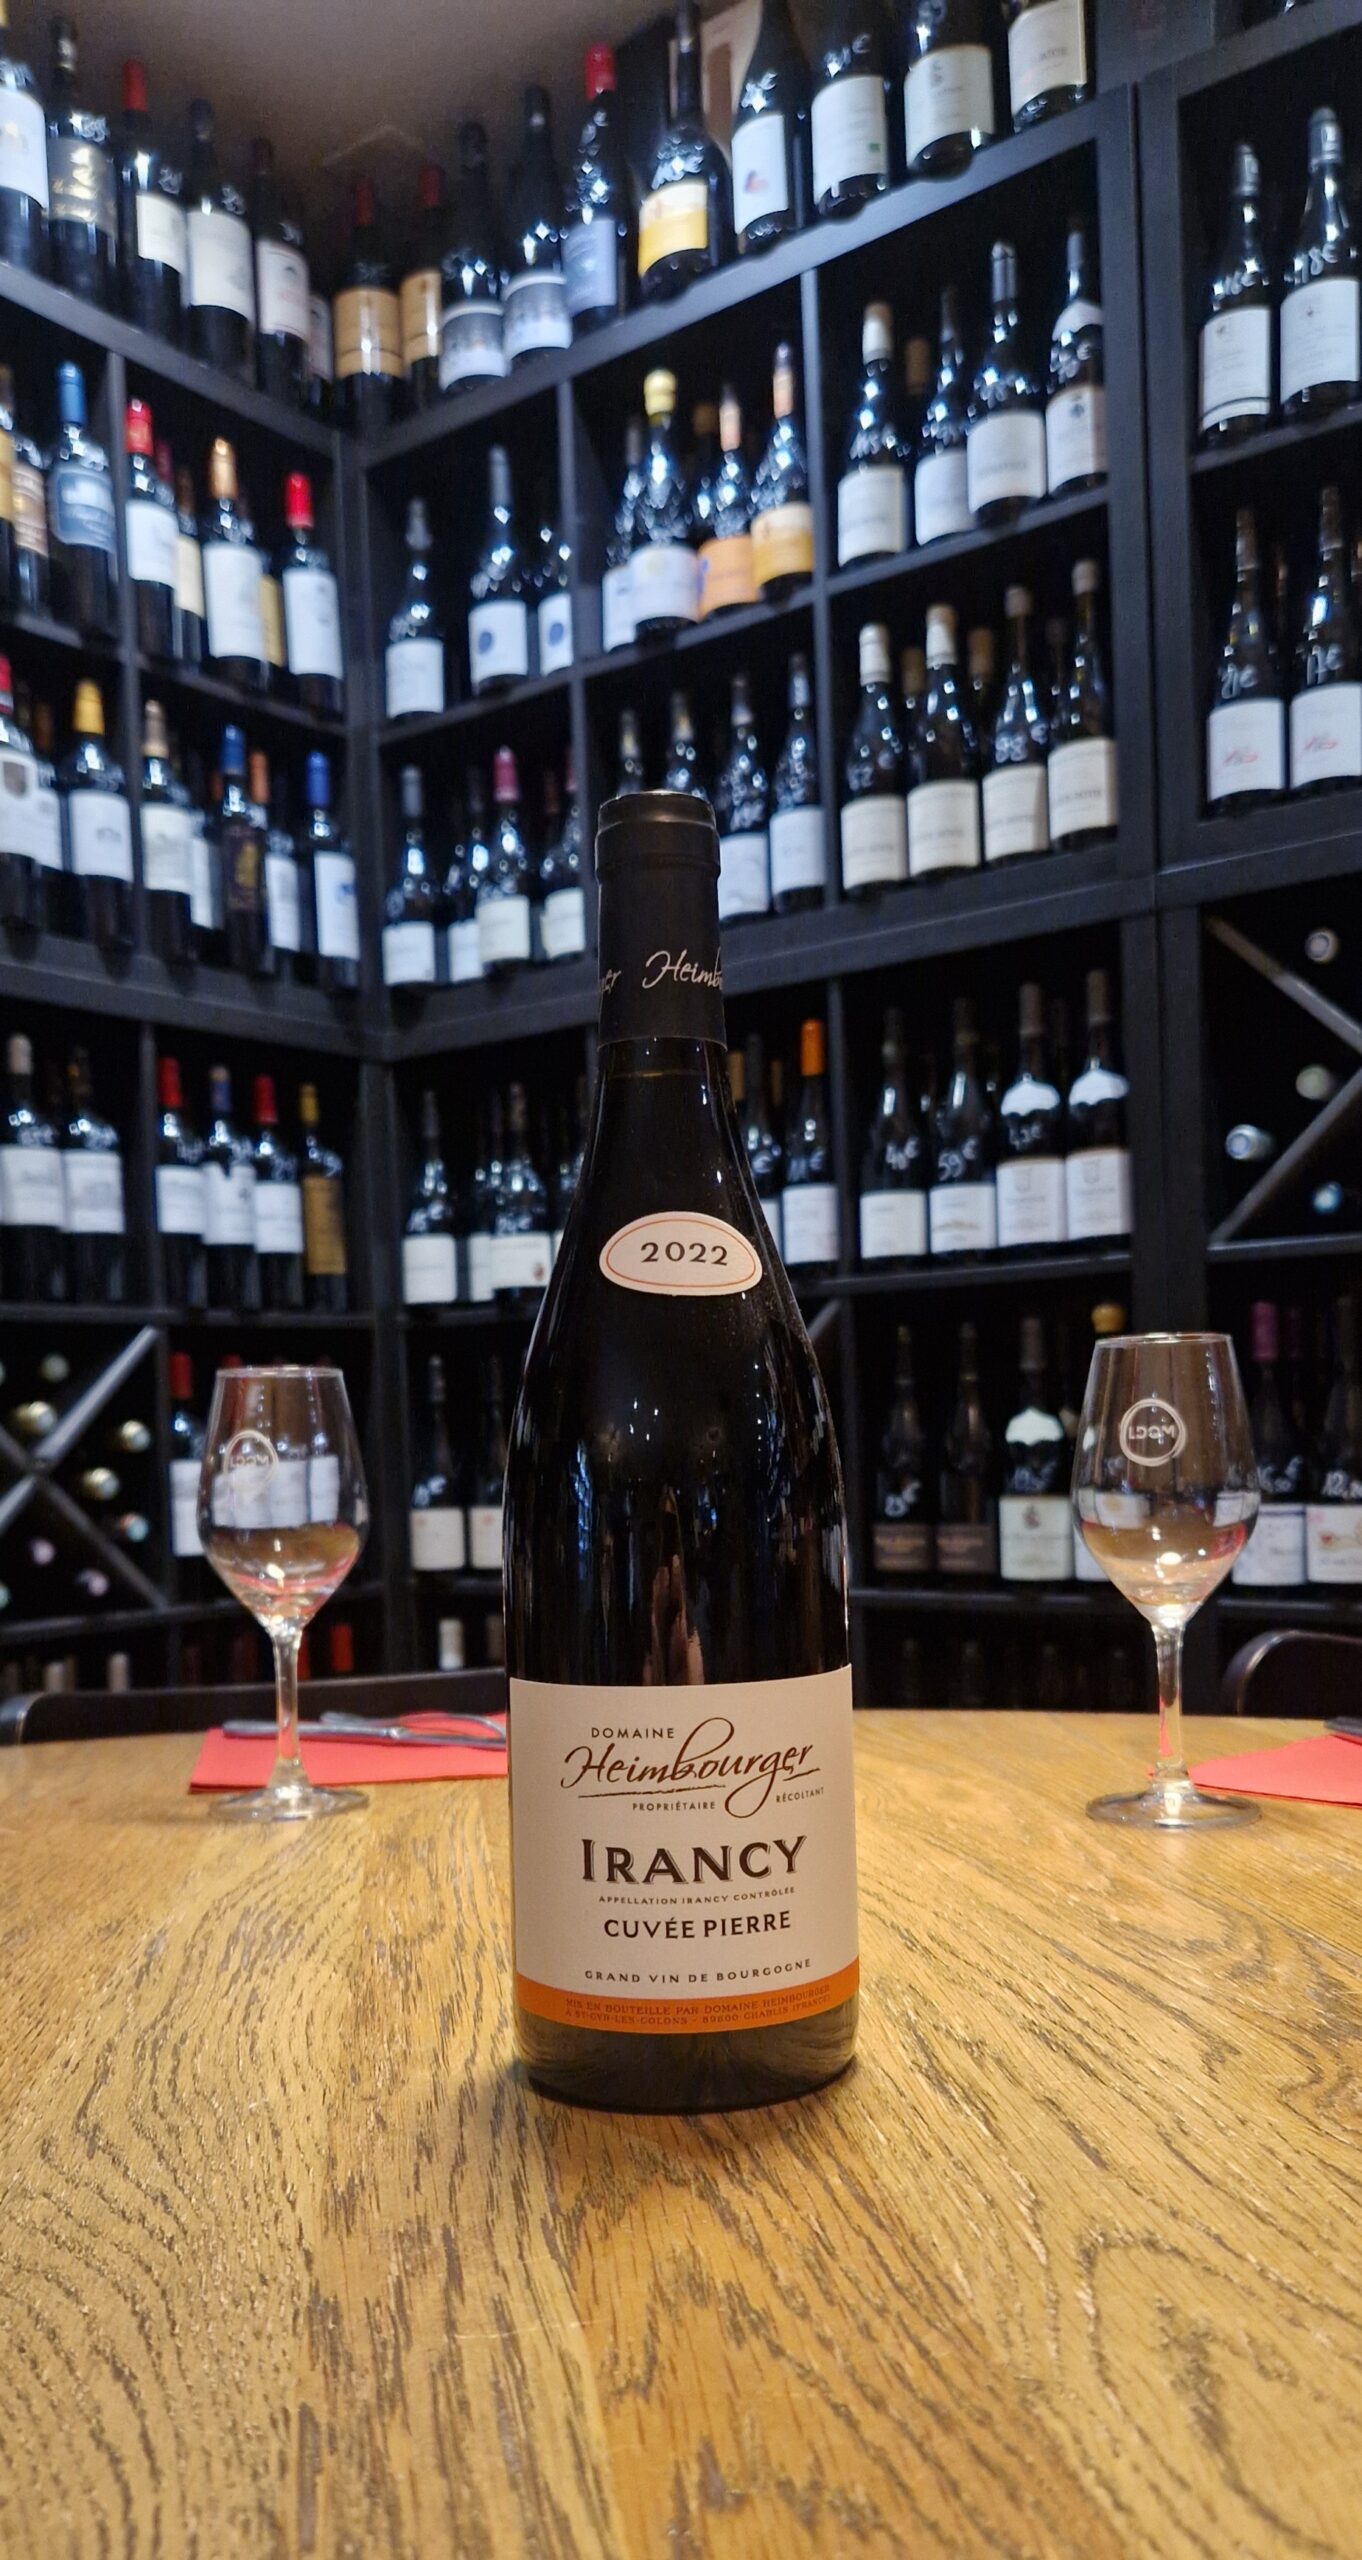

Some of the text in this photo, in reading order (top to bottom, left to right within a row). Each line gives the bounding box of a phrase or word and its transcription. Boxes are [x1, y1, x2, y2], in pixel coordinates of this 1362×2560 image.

[641, 1241, 728, 1266] 2022
[591, 1727, 675, 1739] DOMAINE
[561, 1717, 813, 1819] Heimbourger
[632, 1786, 824, 1811] PROPRIÉTAIRE RÉCOLTANT
[581, 1835, 807, 1885] IRANCY
[599, 1886, 795, 1905] APPELLATION IRANCY CONTRÔLÉE
[604, 1910, 791, 1939] CUVÉE PIERRE
[584, 1958, 811, 1983] GRAND VIN DE BOURGOGNE
[605, 2003, 671, 2016] BOUTEILLE
[676, 2006, 699, 2015] PAR
[704, 2000, 759, 2014] DOMAINE
